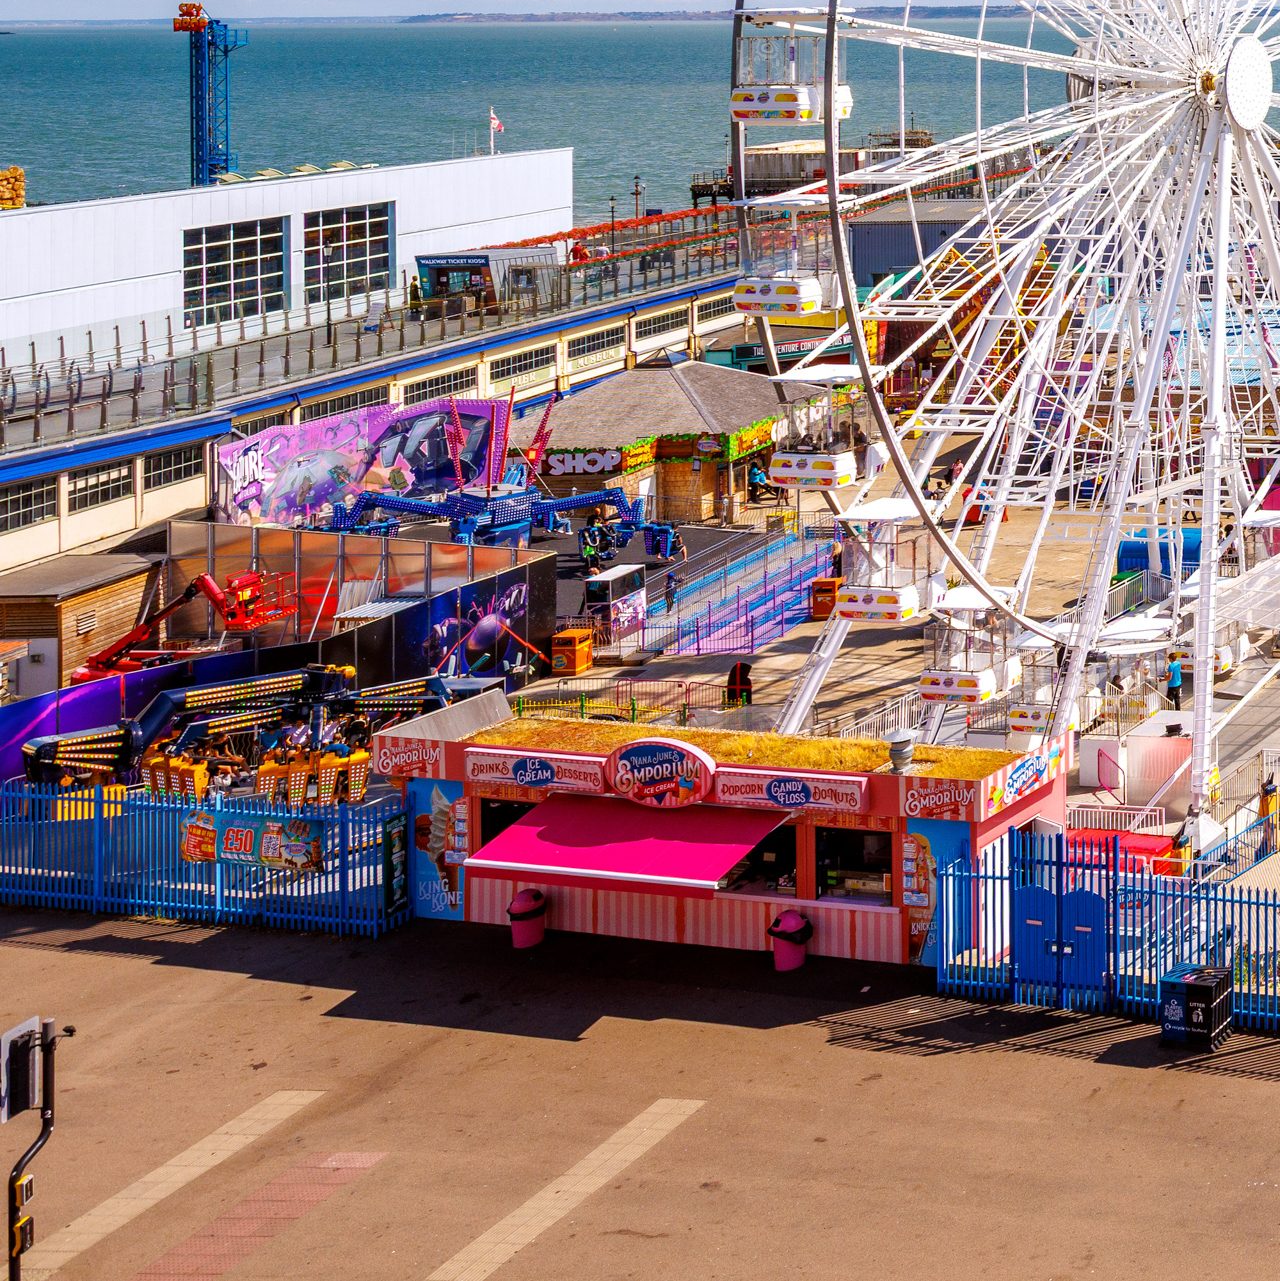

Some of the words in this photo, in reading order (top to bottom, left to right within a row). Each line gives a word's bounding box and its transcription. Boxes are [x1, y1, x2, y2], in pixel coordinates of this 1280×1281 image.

[576, 348, 616, 369] MUSEUM
[511, 372, 537, 387] PIER
[548, 450, 622, 476] SHOP
[378, 747, 441, 774] EMPORIUM
[471, 760, 510, 777] DRINKS
[525, 758, 541, 773] ICE
[630, 755, 652, 767] NANA
[516, 770, 552, 786] CREAM
[555, 765, 601, 786] DESSERTS
[615, 759, 701, 793] EMPORIUM
[655, 782, 676, 792] CREAM
[720, 783, 764, 796] POPCORN
[771, 780, 803, 796] CANDY
[777, 791, 806, 804] FLOSS
[904, 787, 977, 817] EMPORIUM
[223, 827, 255, 853] £50
[418, 878, 449, 900] KING
[431, 890, 464, 913] KONE
[44, 1109, 52, 1119] 2
